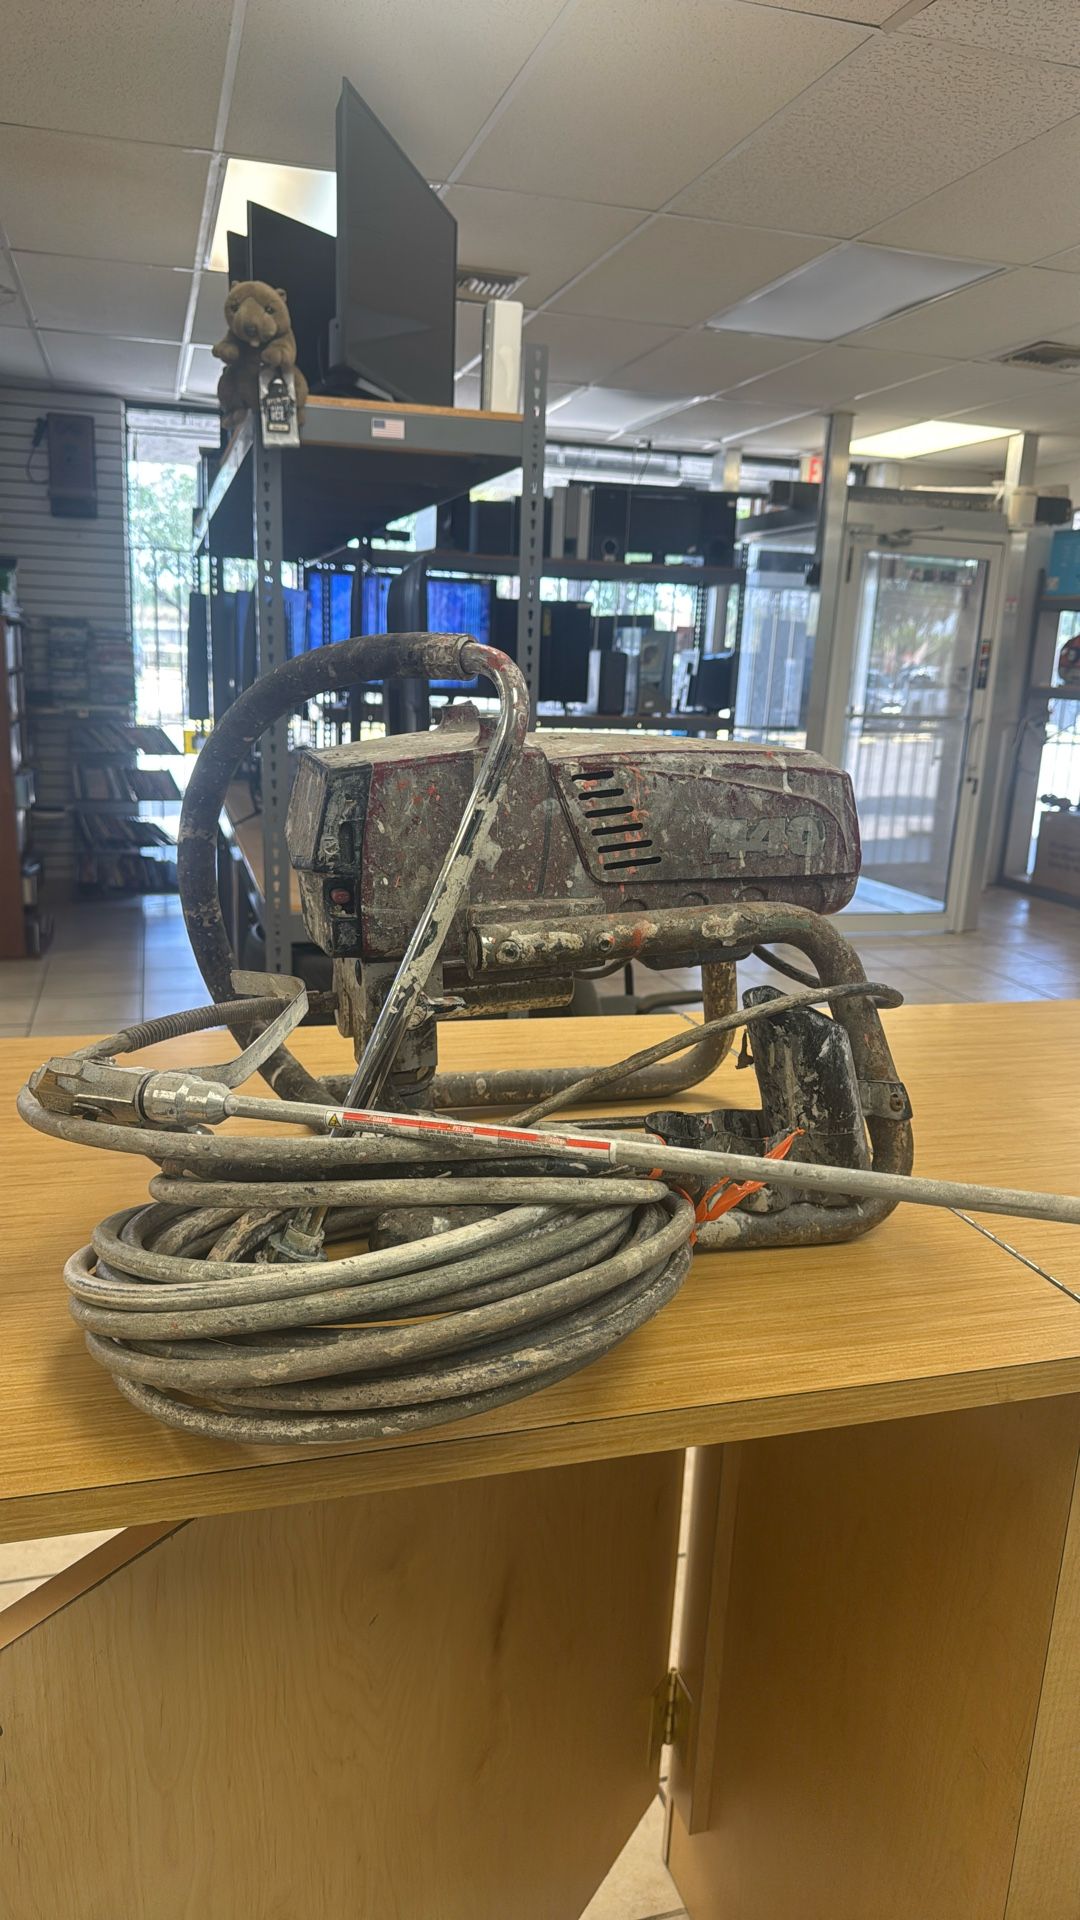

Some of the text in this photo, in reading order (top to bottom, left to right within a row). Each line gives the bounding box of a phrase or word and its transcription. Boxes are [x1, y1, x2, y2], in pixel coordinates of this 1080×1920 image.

[709, 816, 826, 858] 440
[372, 1115, 393, 1124] DANGER
[452, 1125, 475, 1133] PELIGRO
